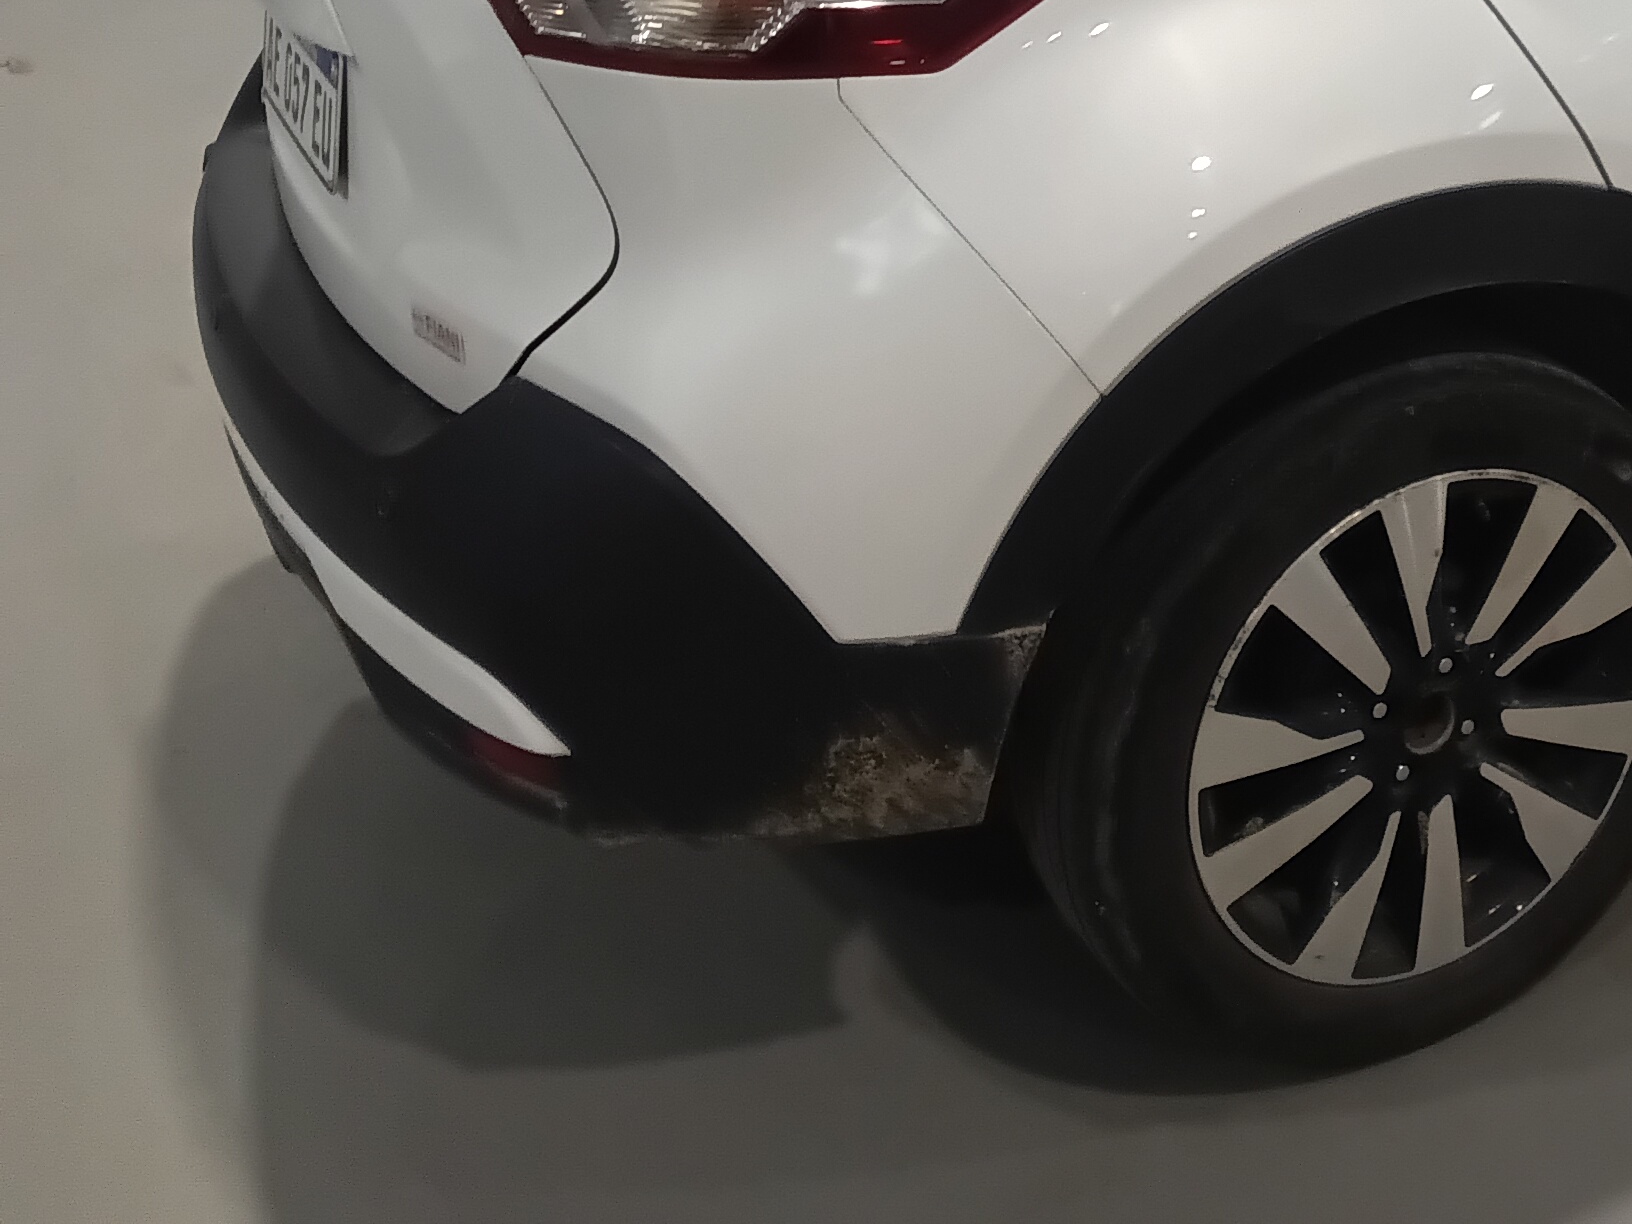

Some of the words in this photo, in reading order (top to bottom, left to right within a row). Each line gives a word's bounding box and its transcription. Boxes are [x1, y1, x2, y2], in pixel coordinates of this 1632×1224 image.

[266, 16, 282, 97] AE
[284, 42, 310, 133] 057
[311, 79, 333, 171] EU
